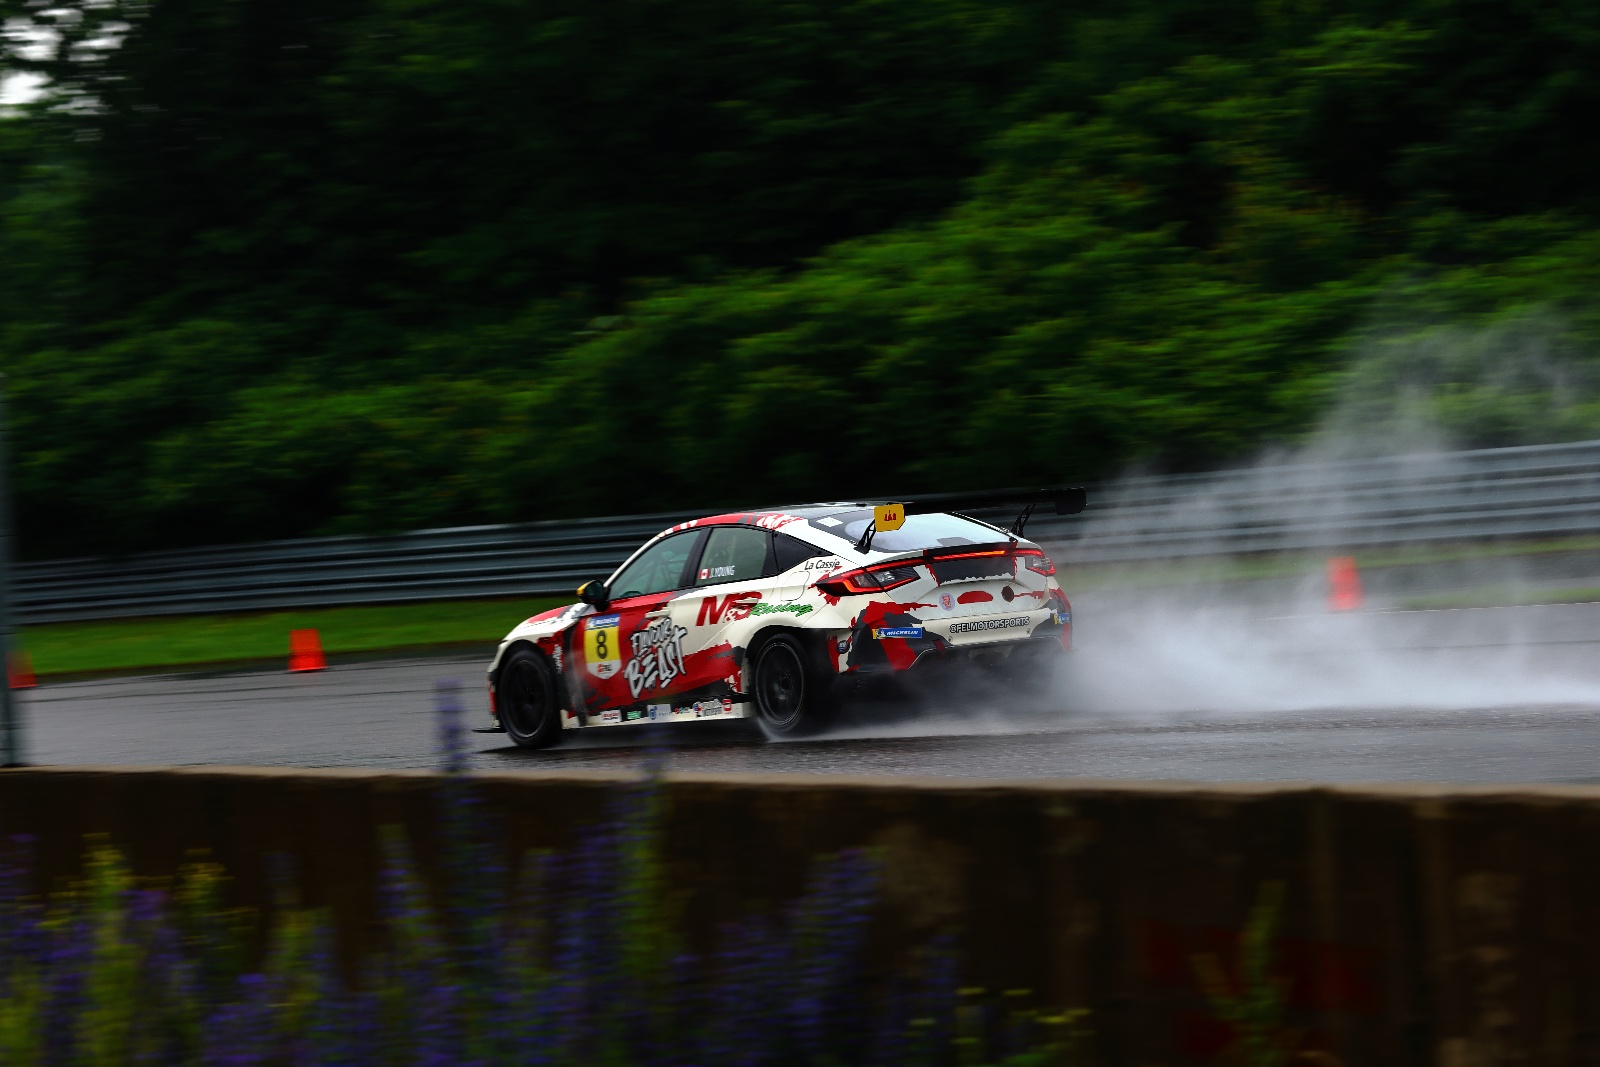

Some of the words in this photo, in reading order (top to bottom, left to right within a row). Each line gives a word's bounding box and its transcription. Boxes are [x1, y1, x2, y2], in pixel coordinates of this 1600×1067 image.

[805, 561, 814, 570] La
[815, 559, 840, 569] Cassie
[950, 616, 1030, 633] @FELMOTORSPORTS
[597, 630, 607, 659] 8
[623, 625, 687, 698] BEAST
